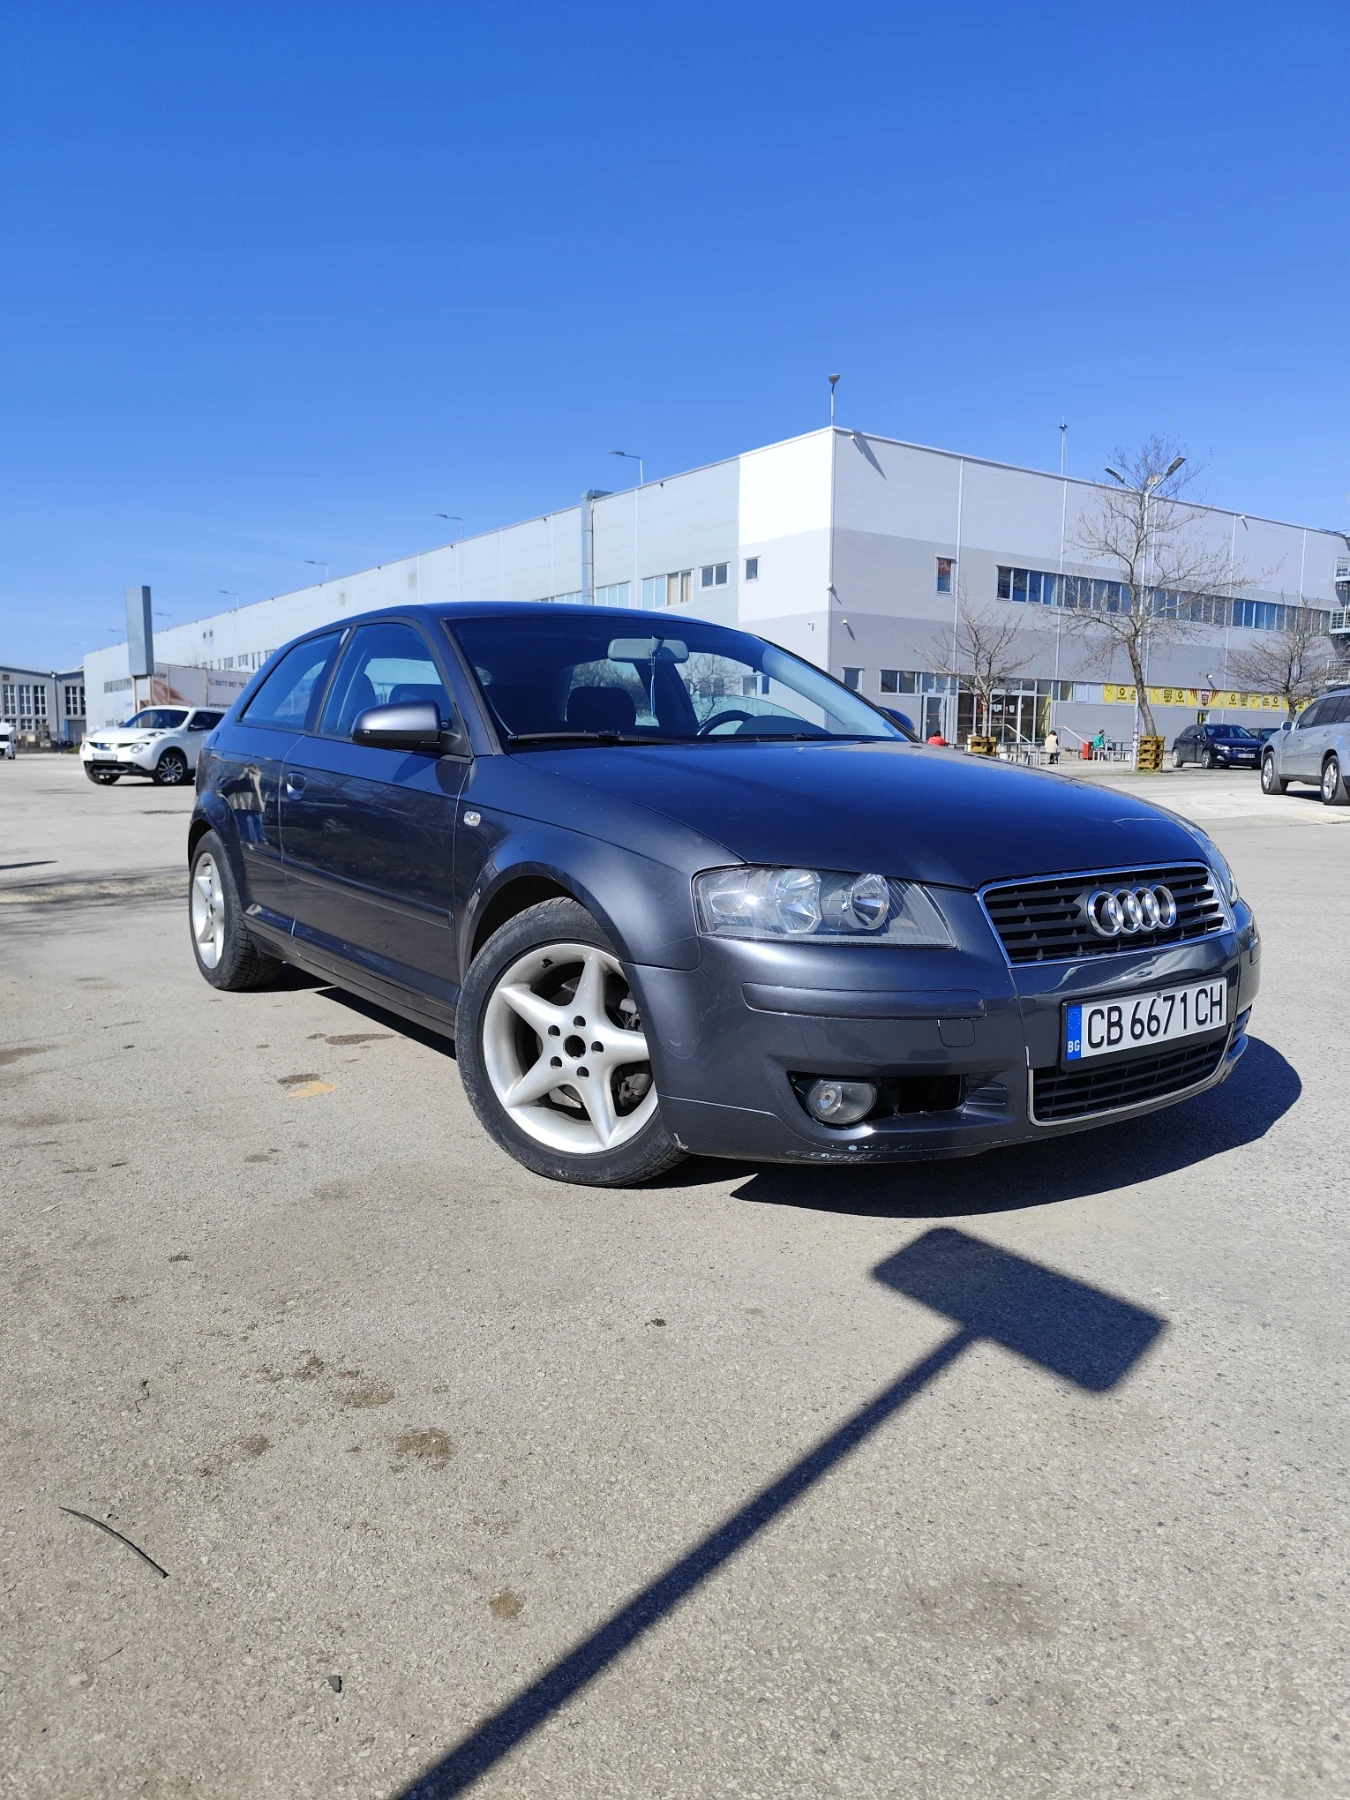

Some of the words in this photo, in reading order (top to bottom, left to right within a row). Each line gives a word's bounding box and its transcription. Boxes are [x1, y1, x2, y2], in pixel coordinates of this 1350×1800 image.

[1087, 1005, 1124, 1049] CB
[1130, 992, 1188, 1041] 6671
[1195, 984, 1223, 1026] CH
[1067, 1040, 1081, 1053] BG
